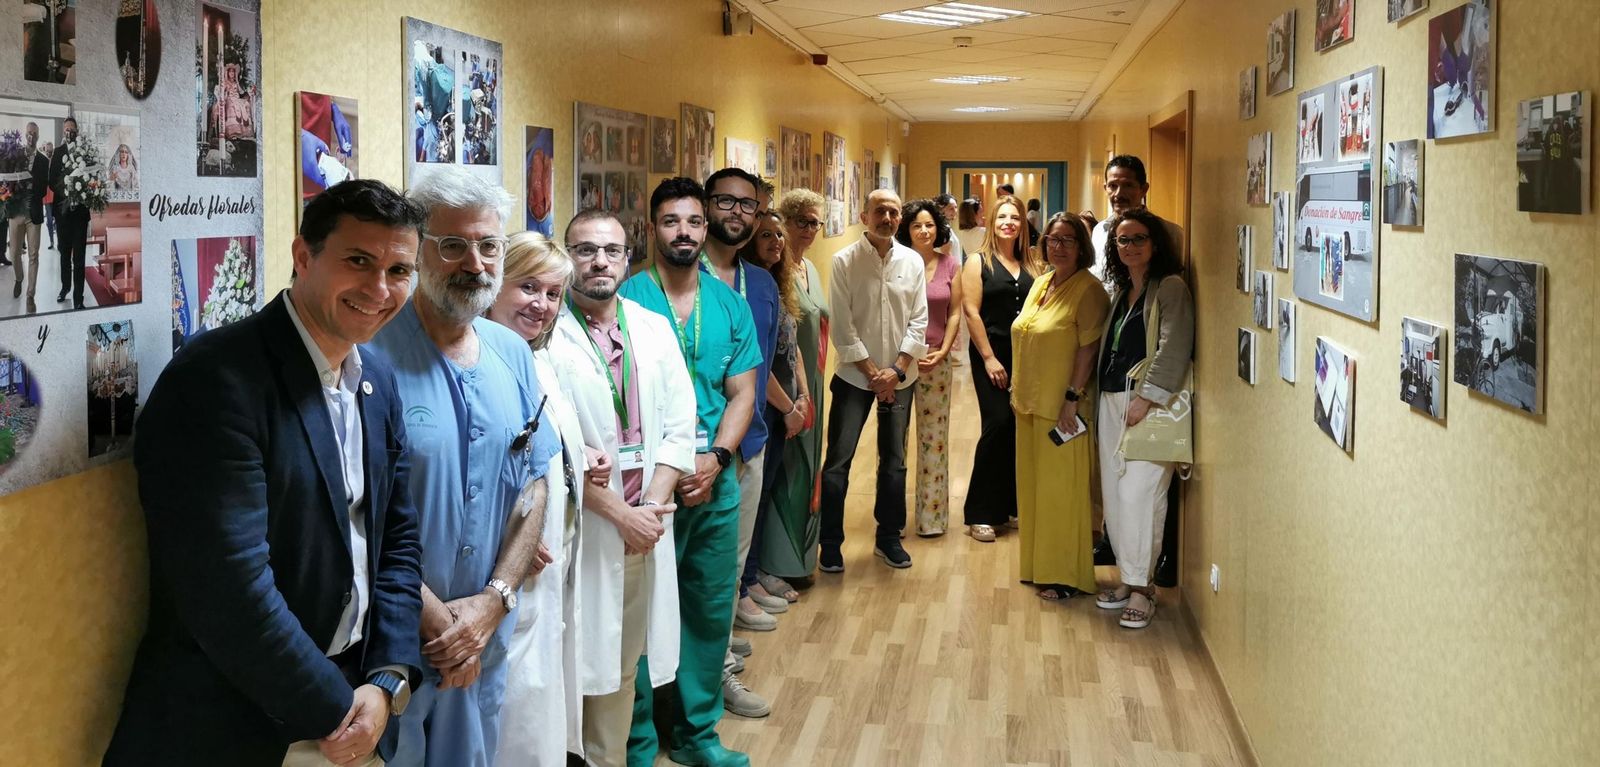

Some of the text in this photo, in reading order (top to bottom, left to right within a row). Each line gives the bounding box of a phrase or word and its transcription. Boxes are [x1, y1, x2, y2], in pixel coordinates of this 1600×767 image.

[149, 193, 255, 222] Ofredas florales
[1330, 206, 1338, 220] de
[1339, 207, 1362, 224] Sangre
[37, 324, 51, 354] y
